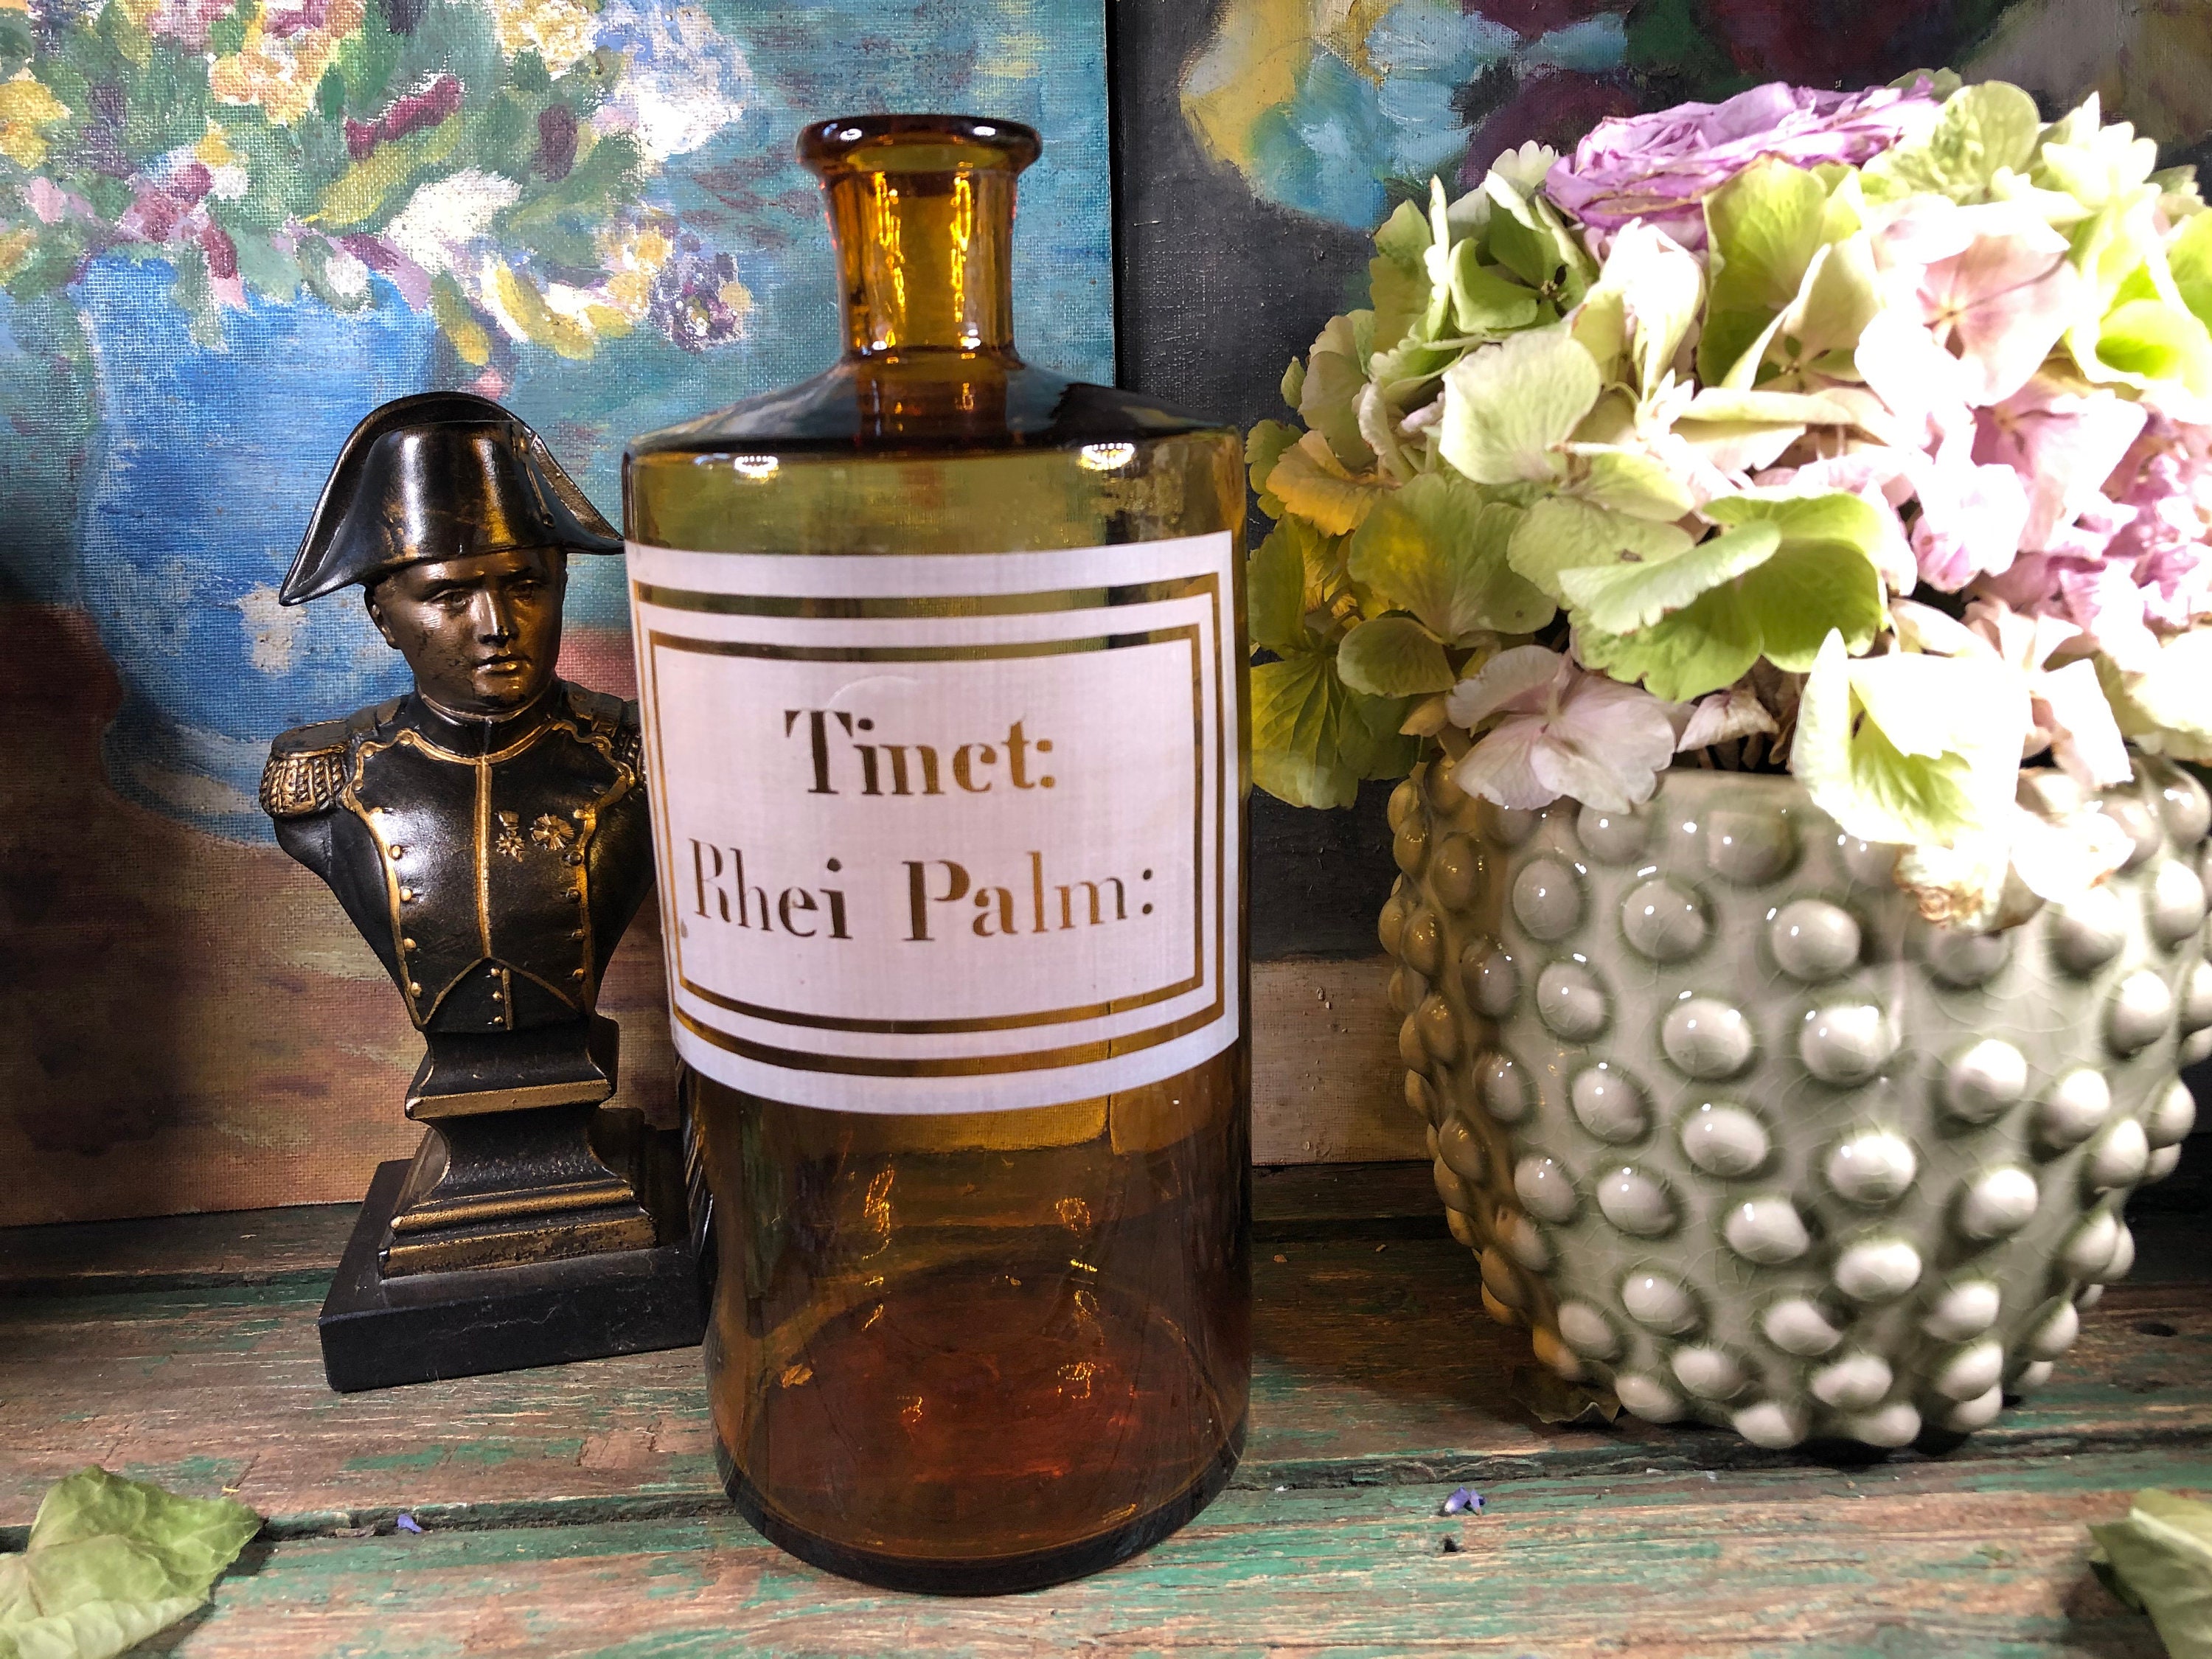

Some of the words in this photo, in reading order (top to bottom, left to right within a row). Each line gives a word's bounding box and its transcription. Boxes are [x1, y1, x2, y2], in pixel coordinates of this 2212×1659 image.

[784, 708, 1057, 796] Tinct:
[689, 838, 853, 941] Rhei
[901, 851, 1155, 942] Palm:
